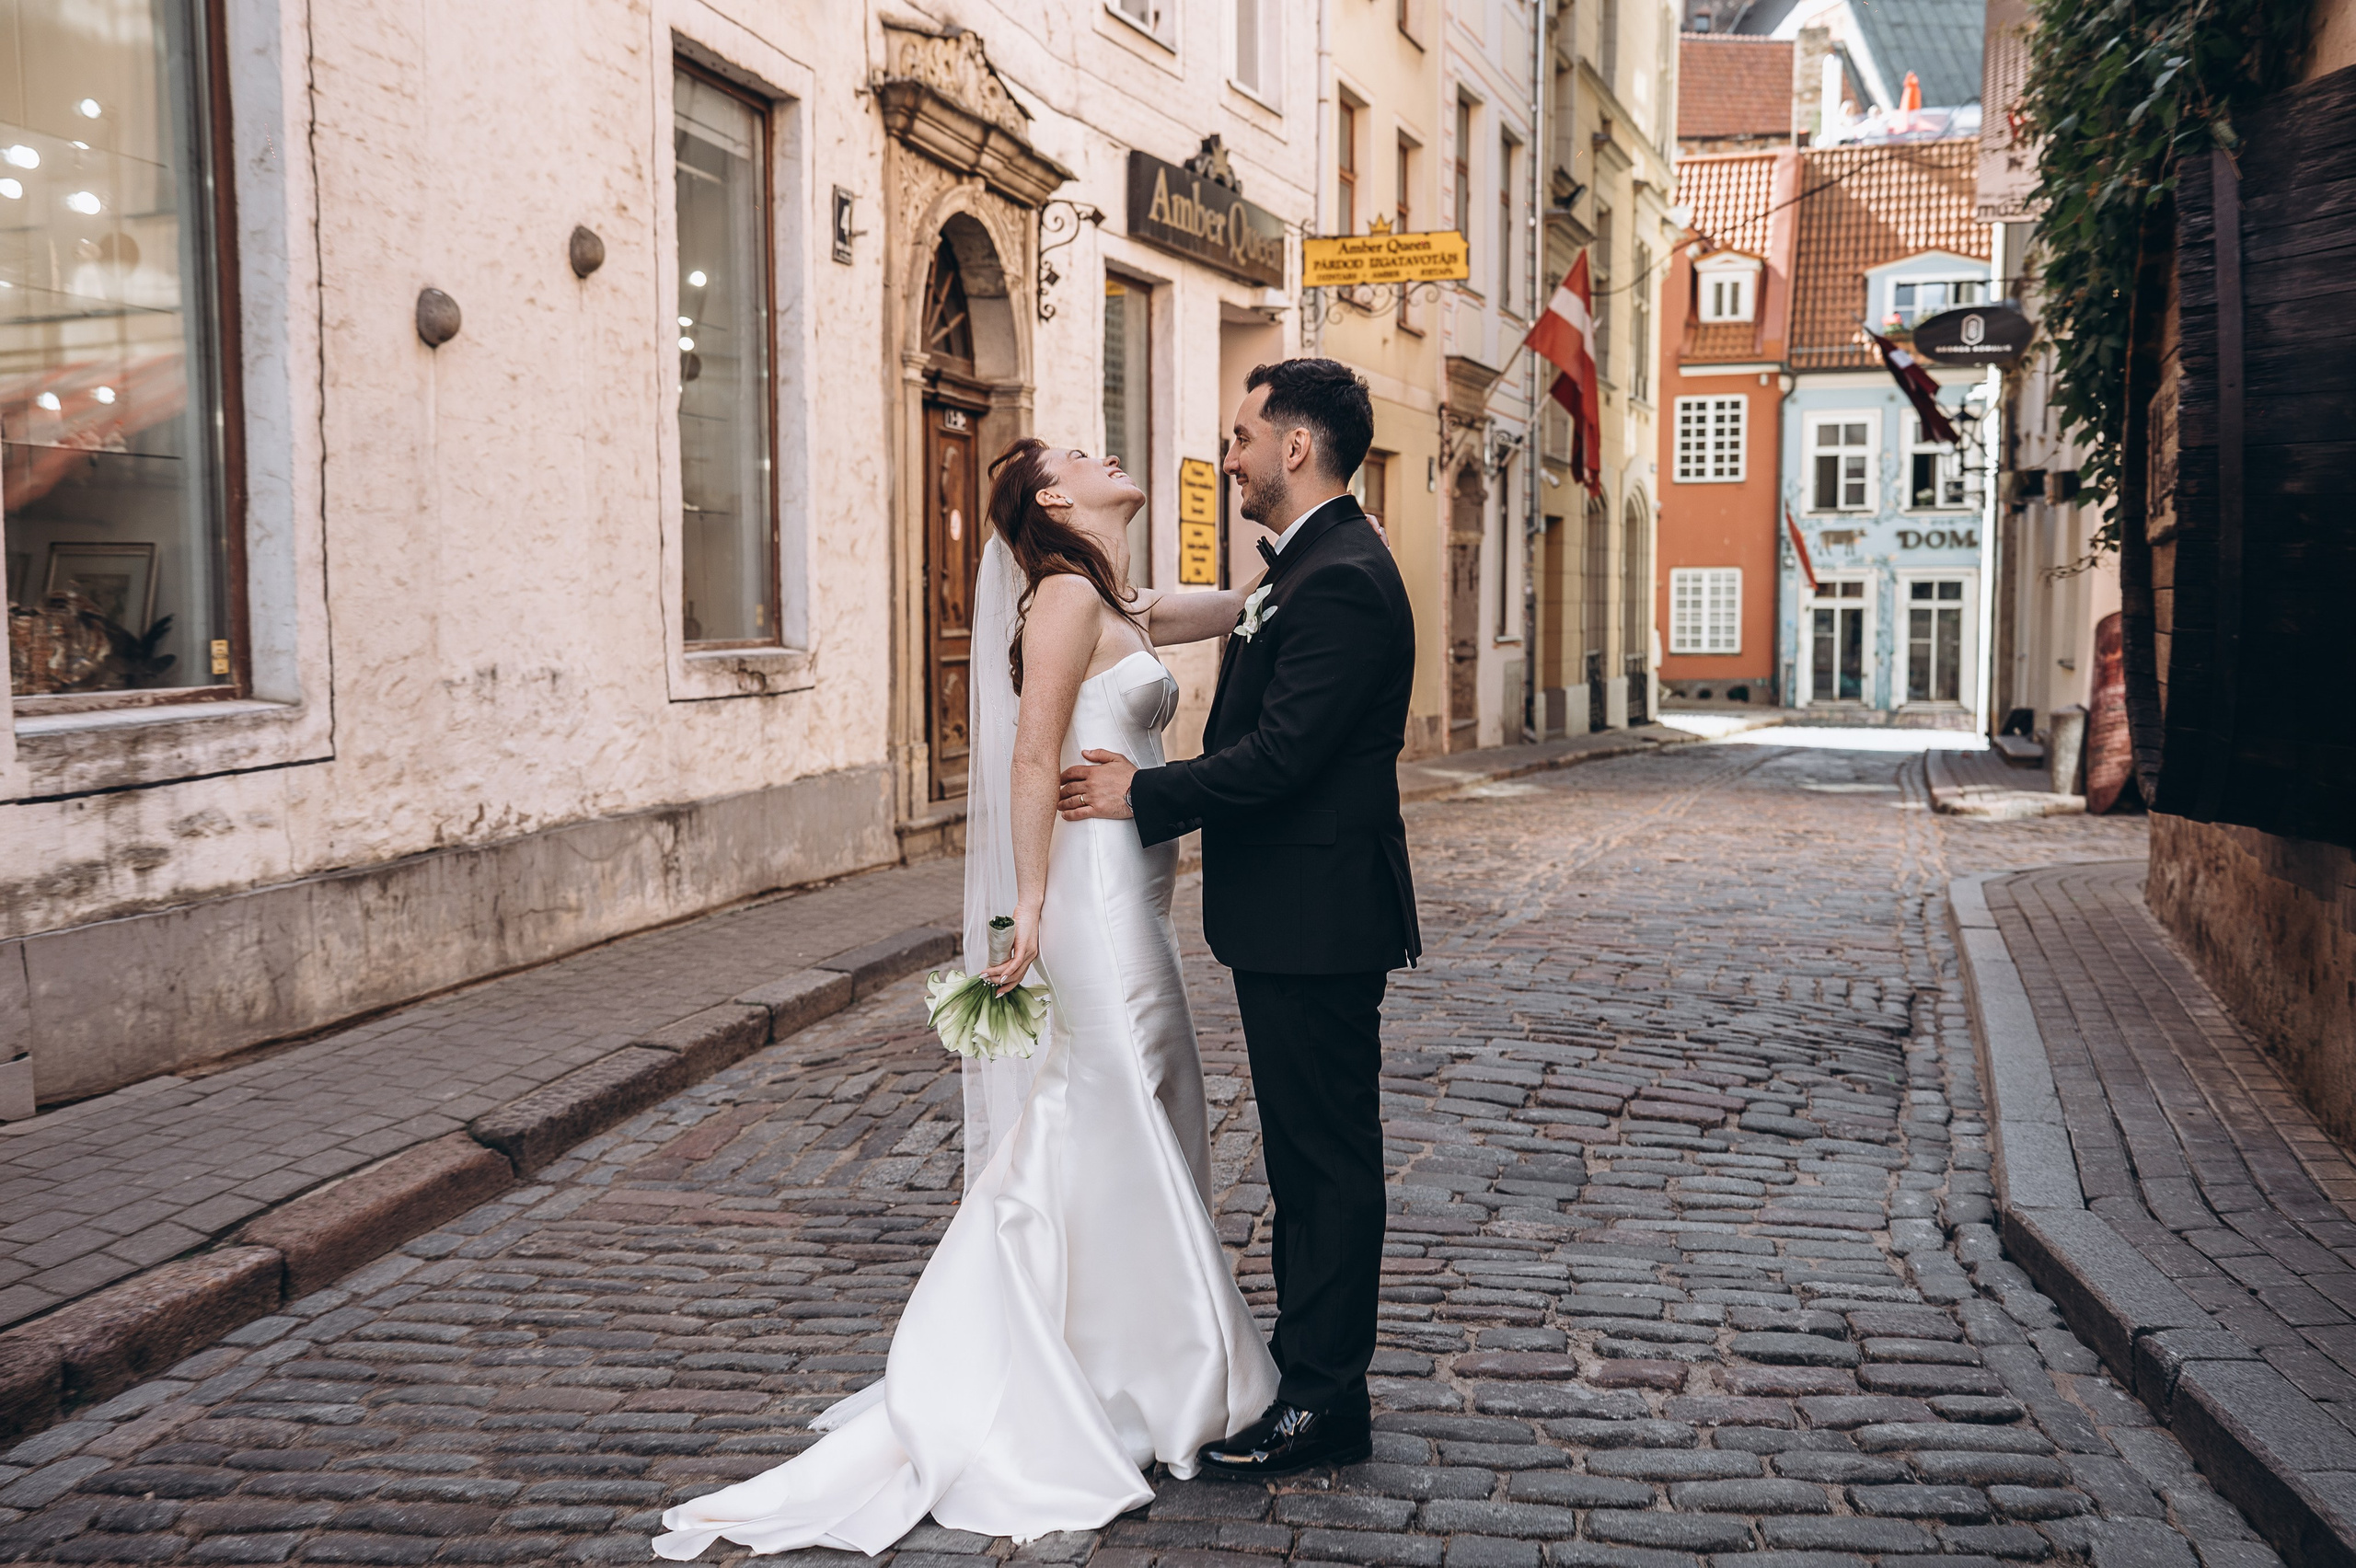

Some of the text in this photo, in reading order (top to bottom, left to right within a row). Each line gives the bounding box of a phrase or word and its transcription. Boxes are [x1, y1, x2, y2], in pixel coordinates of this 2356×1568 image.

[1148, 166, 1284, 269] Amber Queen
[1337, 238, 1431, 255] Amber Queen
[1896, 528, 1979, 550] DOM
